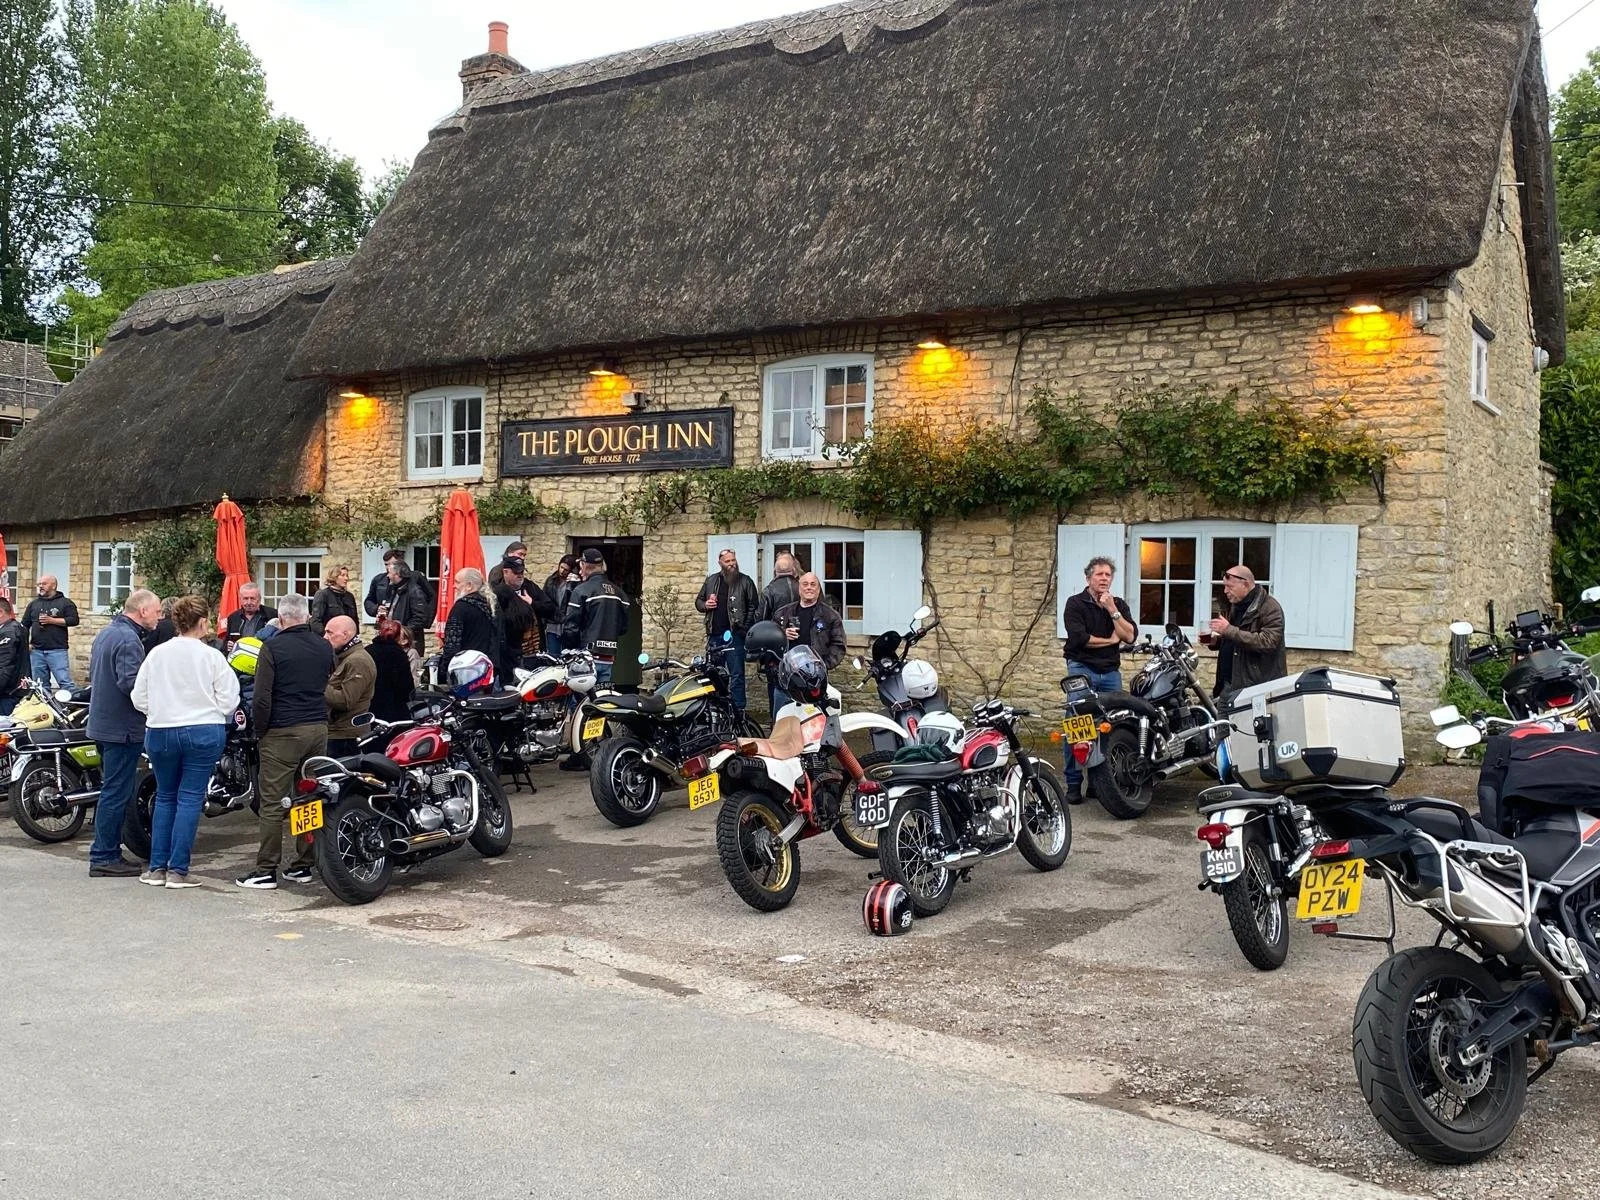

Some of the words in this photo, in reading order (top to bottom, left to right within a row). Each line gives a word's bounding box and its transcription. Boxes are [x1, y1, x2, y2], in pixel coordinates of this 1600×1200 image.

[517, 430, 559, 456] THE
[565, 424, 658, 455] PLOUGH
[667, 421, 713, 449] INN
[582, 456, 598, 465] FREE
[600, 454, 622, 463] HOUSE
[626, 453, 641, 464] 1772
[1063, 715, 1092, 730] T800
[1071, 727, 1092, 741] AWM
[1281, 743, 1296, 756] UK
[695, 777, 713, 793] JEG
[693, 788, 716, 806] 953Y
[859, 792, 886, 809] GDF
[295, 803, 318, 820] T55
[858, 807, 886, 824] 40D
[295, 815, 318, 833] NPC
[1206, 847, 1234, 863] KKH
[1206, 860, 1237, 877] 251D
[1304, 862, 1360, 889] OY24
[1307, 887, 1351, 914] PZW
